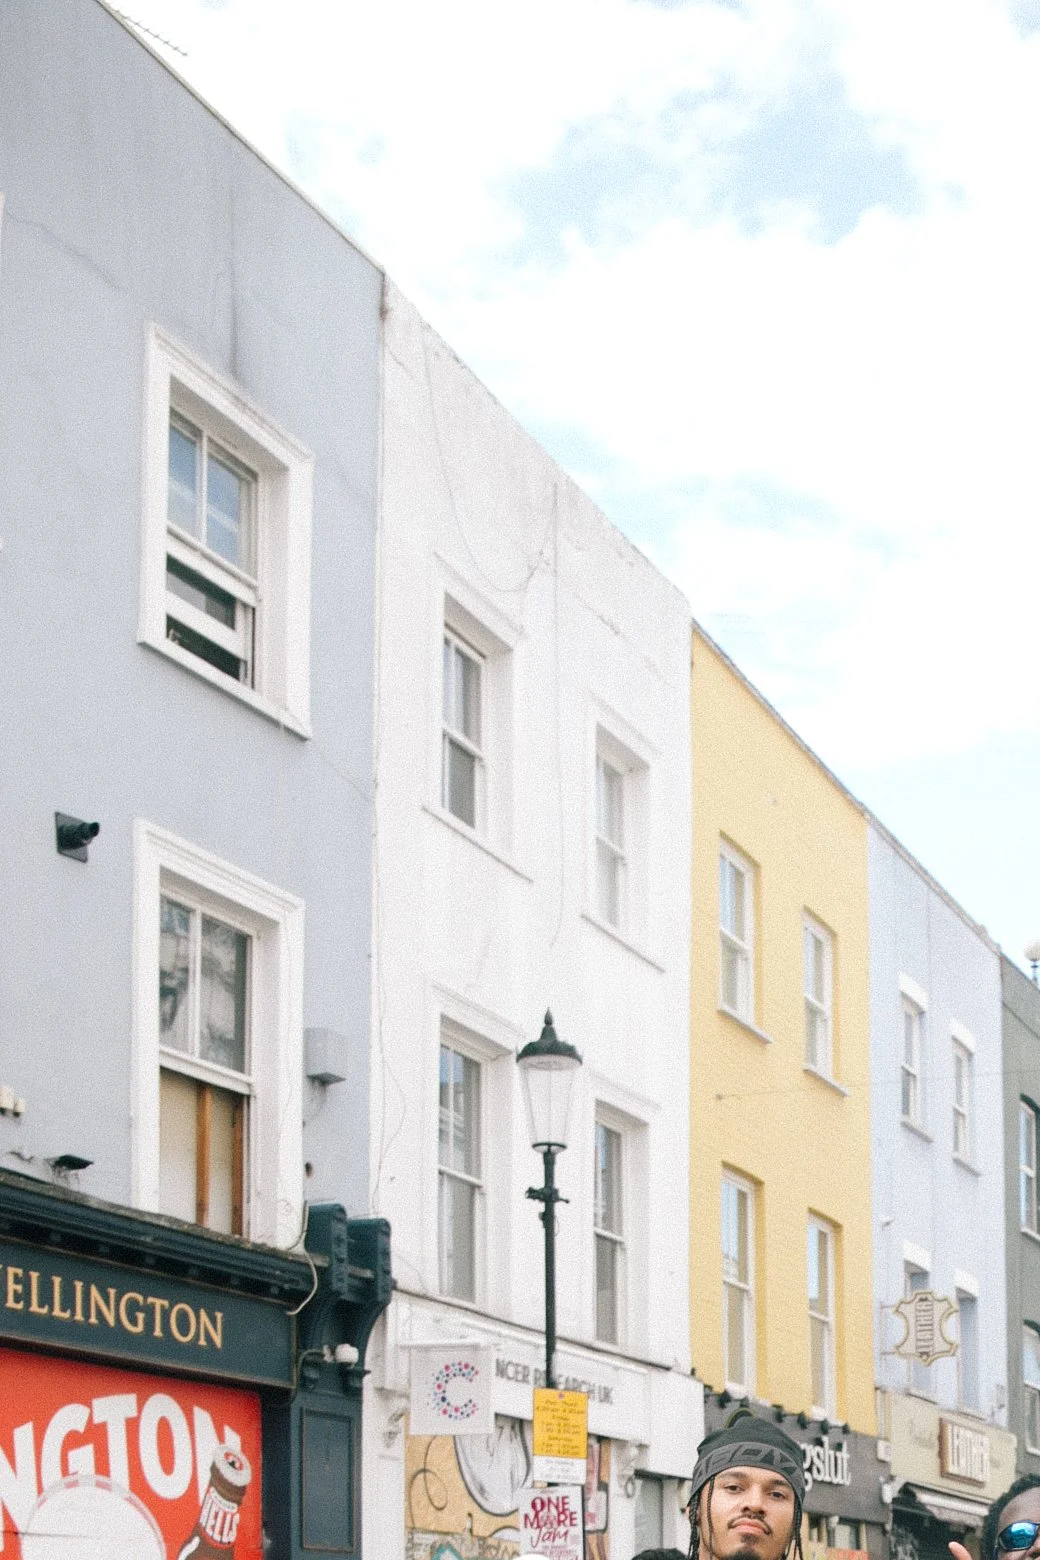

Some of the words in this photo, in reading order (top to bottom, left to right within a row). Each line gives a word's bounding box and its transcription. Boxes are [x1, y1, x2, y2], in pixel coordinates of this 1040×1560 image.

[0, 1264, 223, 1349] ELLINGTON
[495, 1358, 530, 1384] NCER
[531, 1496, 570, 1513] ONE
